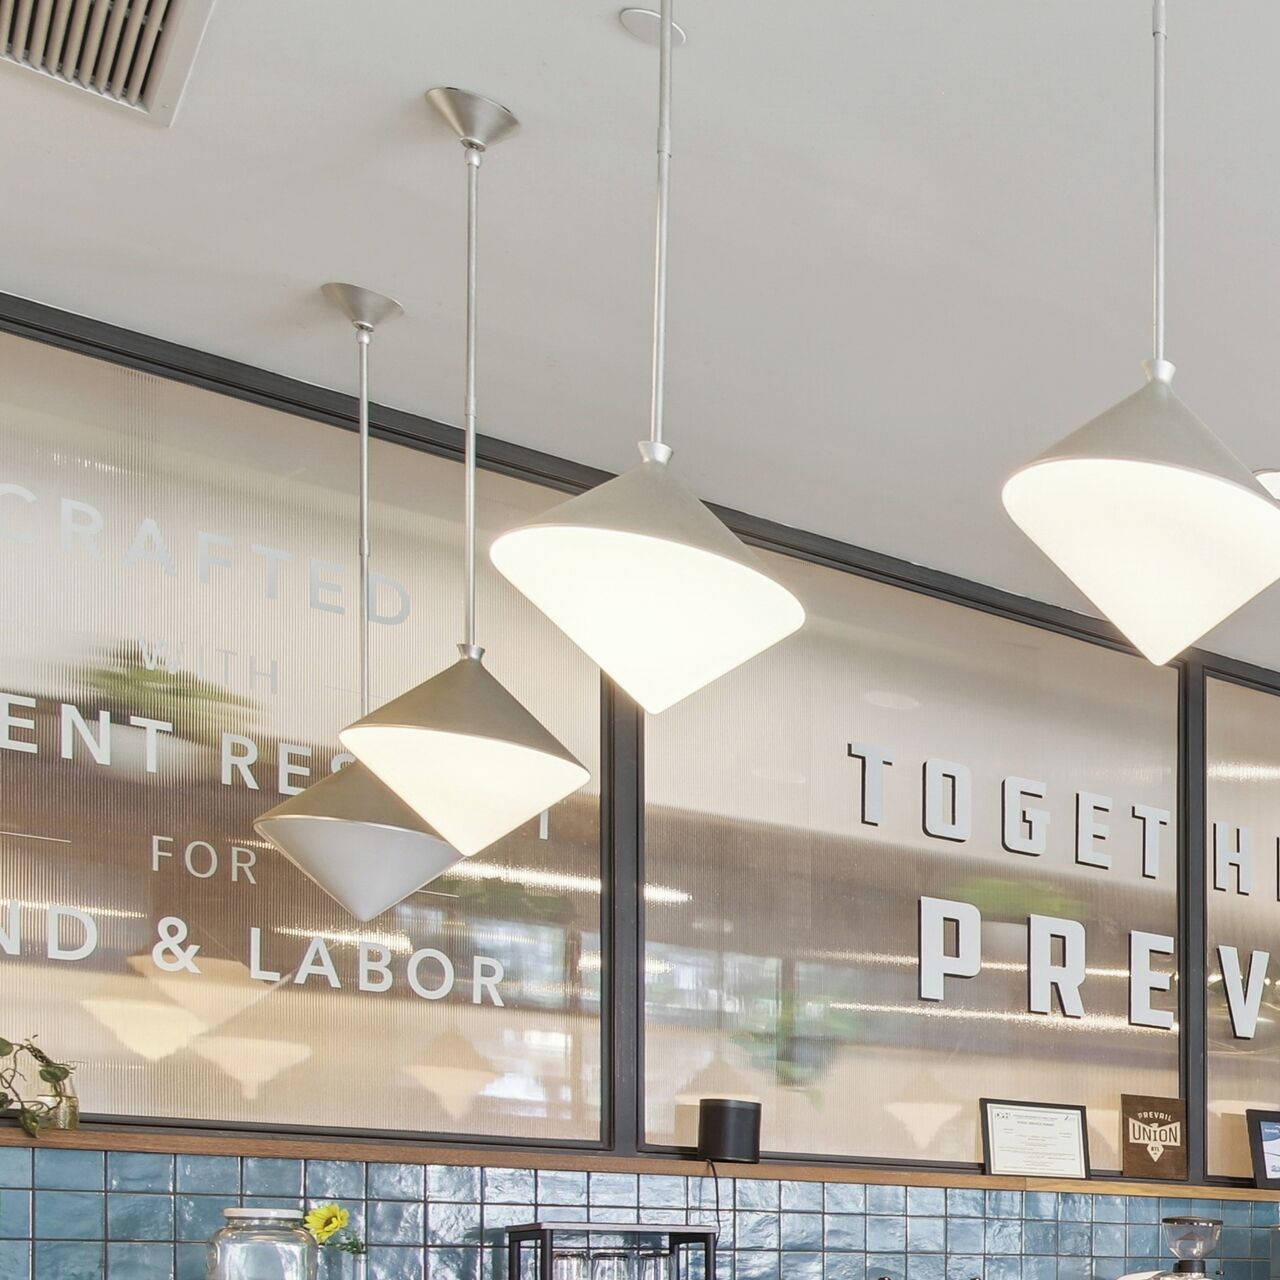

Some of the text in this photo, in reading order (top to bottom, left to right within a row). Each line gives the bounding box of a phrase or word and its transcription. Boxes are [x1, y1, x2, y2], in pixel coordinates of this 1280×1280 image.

[138, 633, 279, 696] WITH
[151, 835, 257, 885] FOR
[152, 917, 201, 974] &
[250, 927, 505, 1007] LABOR
[1132, 1122, 1178, 1143] UNION
[1138, 1111, 1172, 1122] PREVAIL
